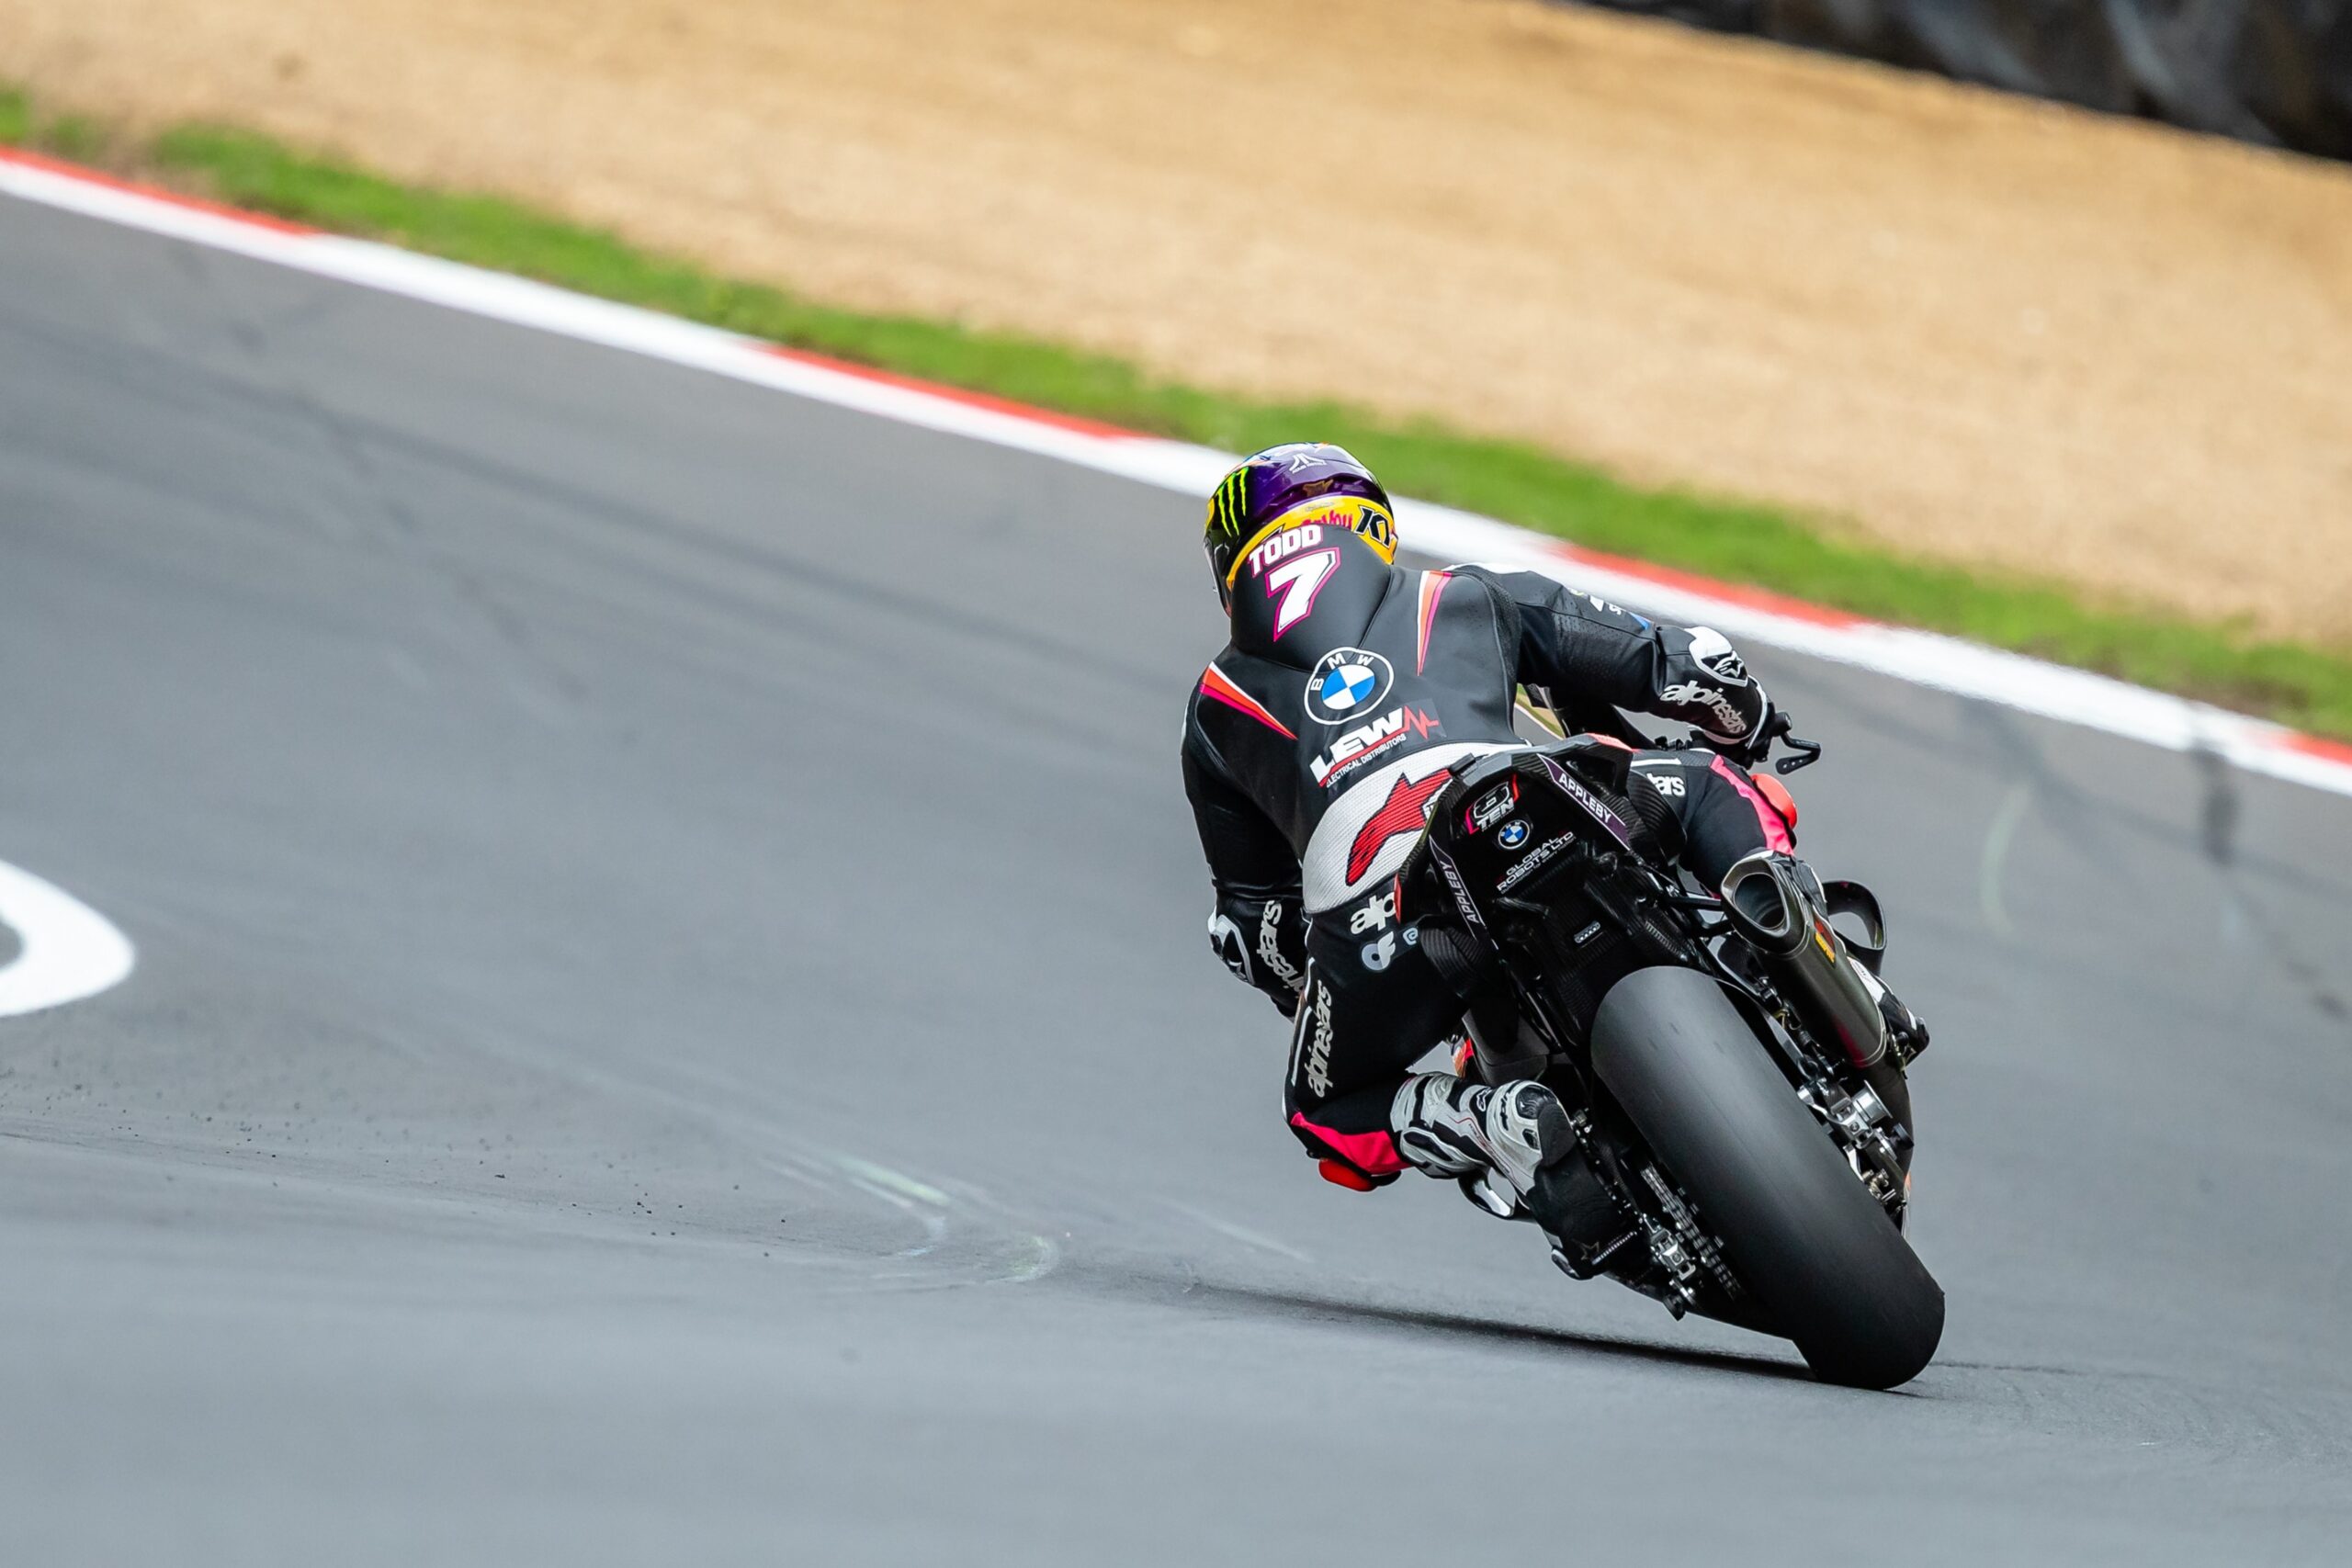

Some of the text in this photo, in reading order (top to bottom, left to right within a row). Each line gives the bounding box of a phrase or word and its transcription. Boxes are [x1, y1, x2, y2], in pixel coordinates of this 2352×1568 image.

[1248, 524, 1322, 577] TODD
[1266, 547, 1340, 641] 7
[1310, 652, 1374, 692] BMW
[1659, 680, 1747, 734] alpinestars
[1309, 707, 1403, 784] LEW
[1361, 732, 1407, 765] DISTRIBUTORS
[1558, 773, 1611, 823] APPLEBY
[1497, 831, 1575, 891] ROBOTS LTD
[1506, 837, 1559, 876] GLOBAL
[1439, 860, 1480, 923] APPLEBY
